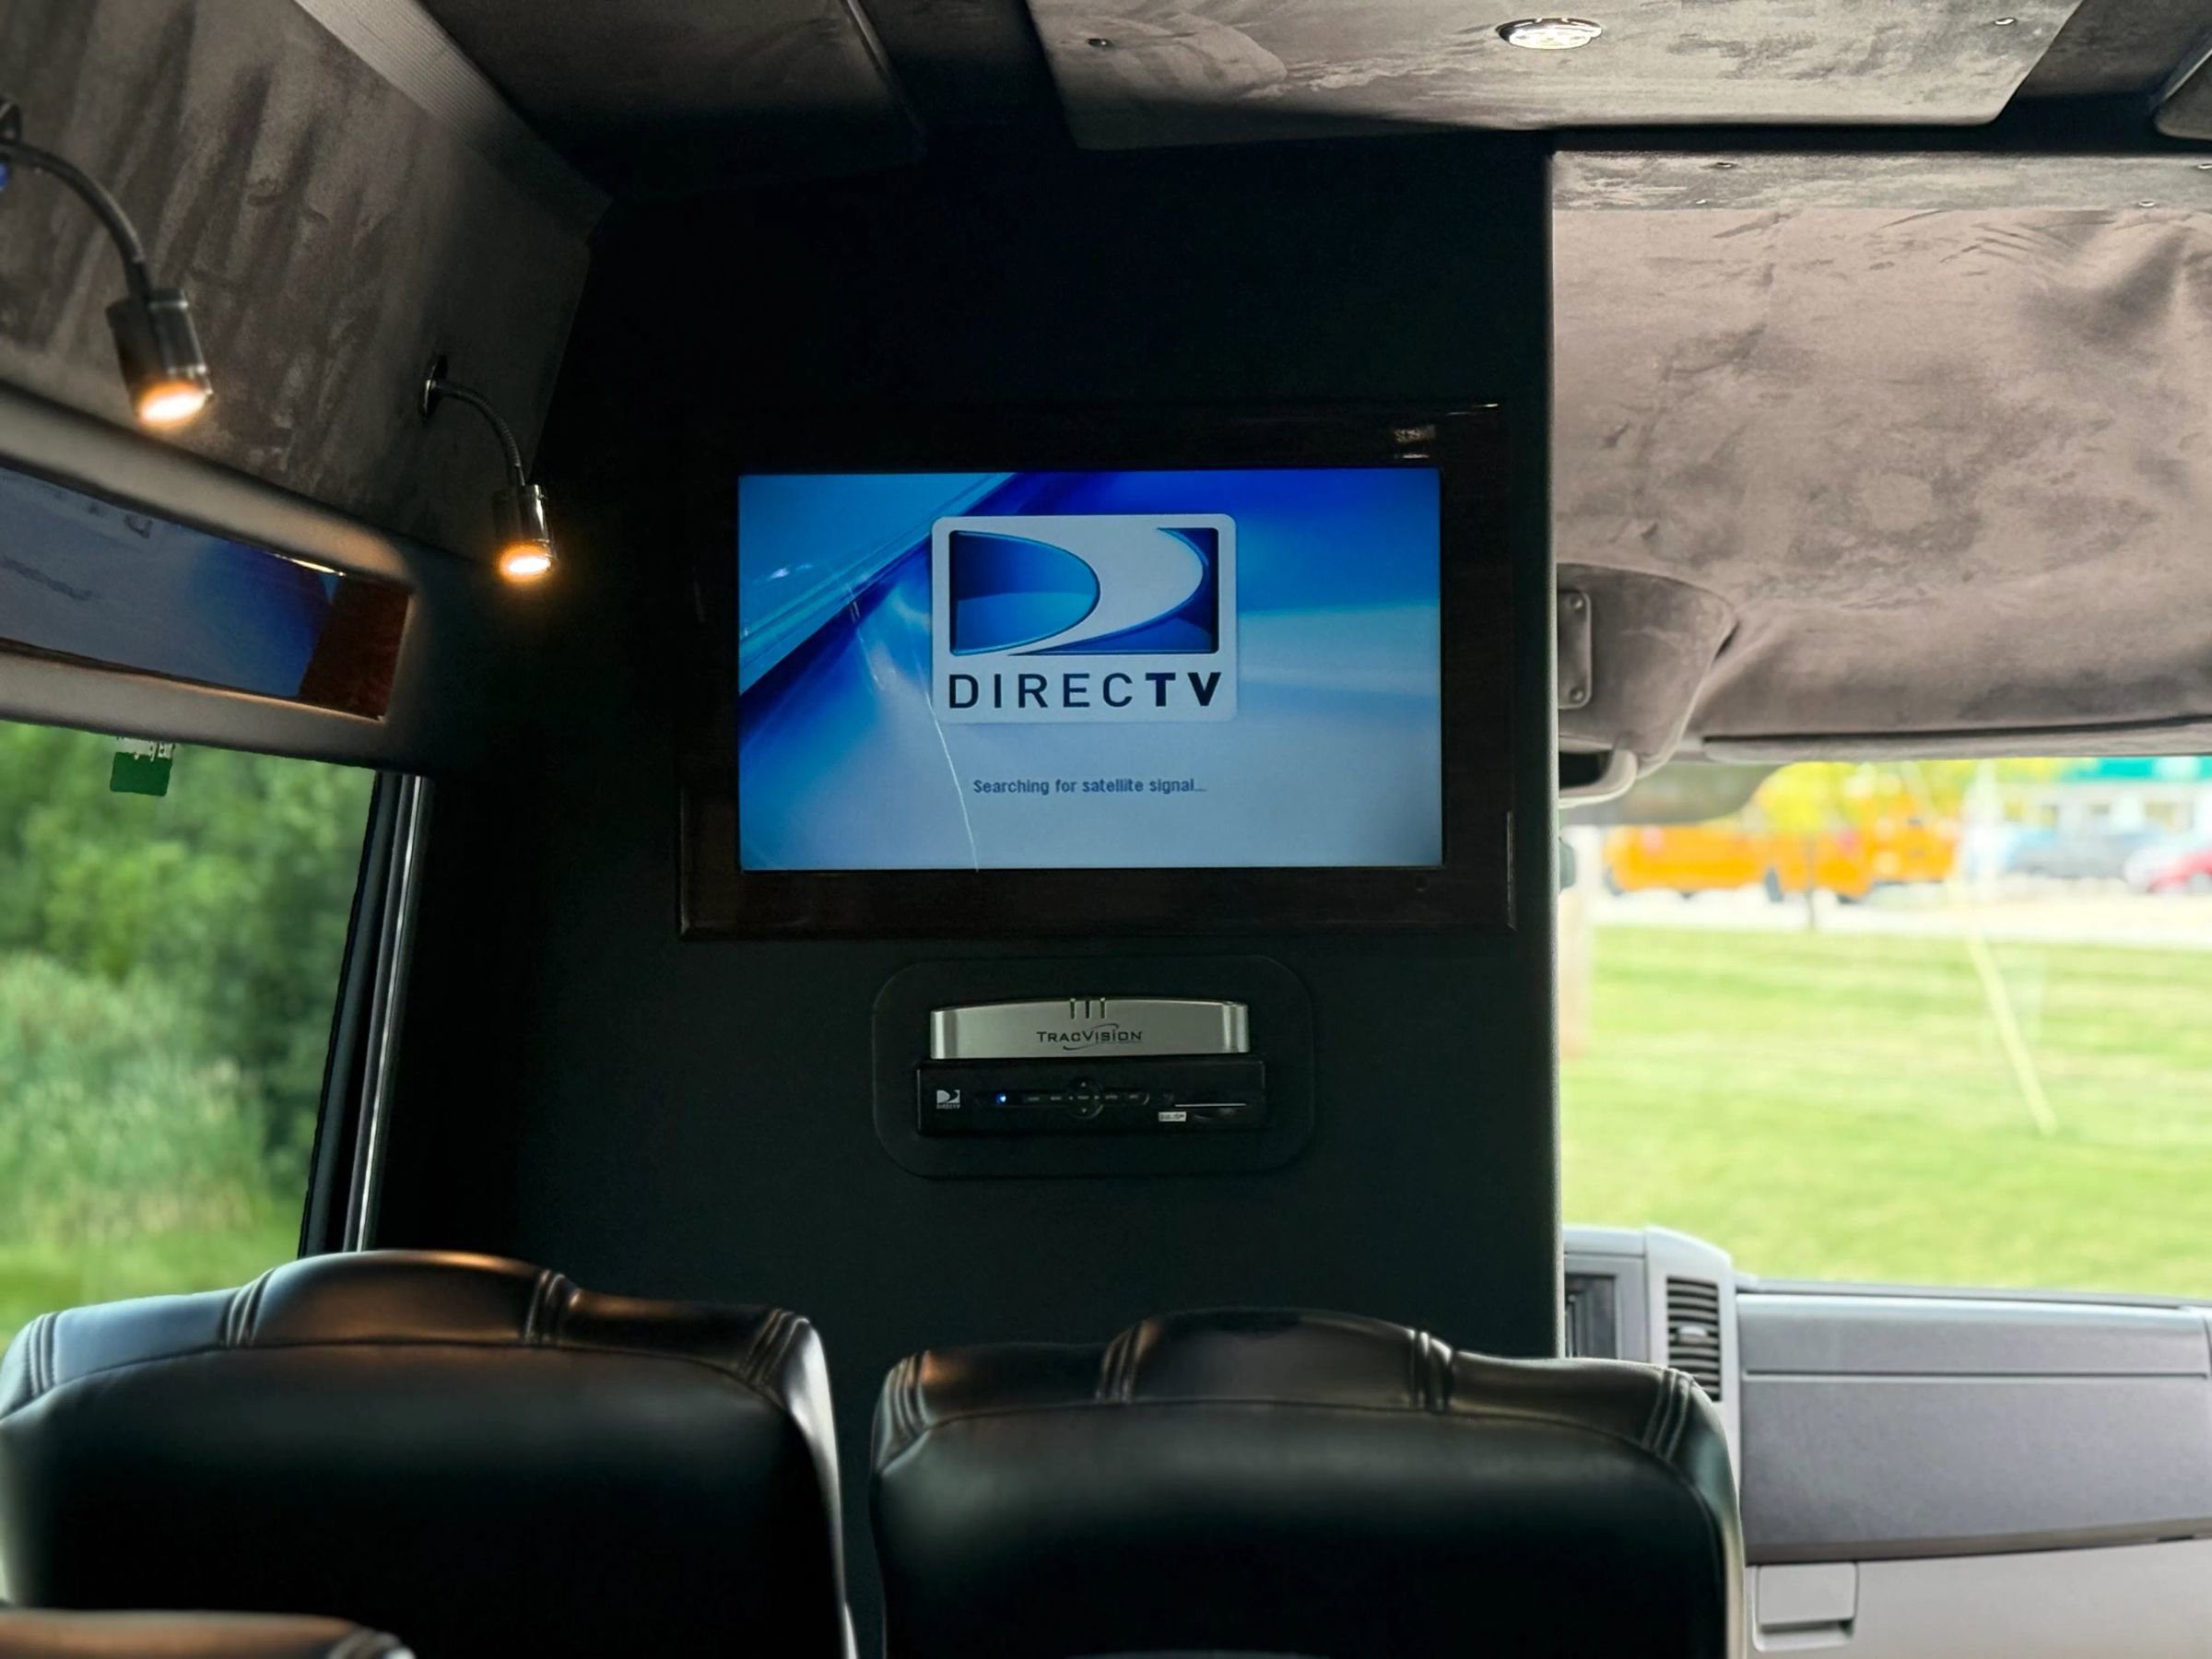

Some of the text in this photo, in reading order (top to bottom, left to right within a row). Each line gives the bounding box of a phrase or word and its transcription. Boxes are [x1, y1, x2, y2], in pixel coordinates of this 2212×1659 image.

[948, 671, 1222, 709] DIRECTV
[972, 779, 1050, 795] Searching
[1055, 779, 1077, 793] for
[1082, 778, 1144, 793] satellite
